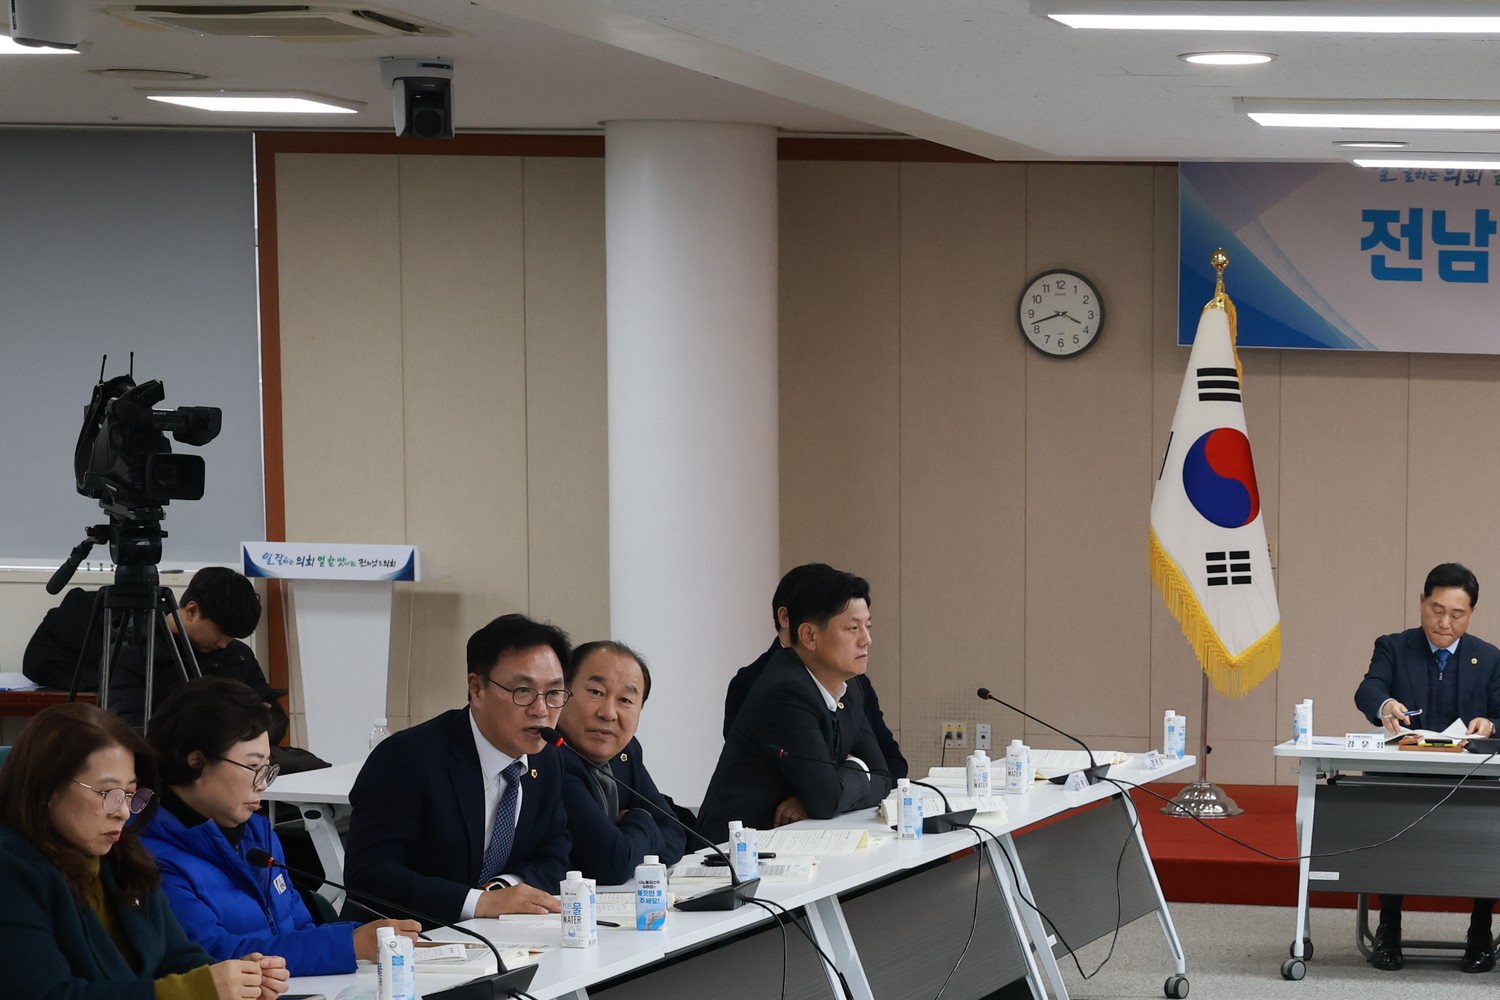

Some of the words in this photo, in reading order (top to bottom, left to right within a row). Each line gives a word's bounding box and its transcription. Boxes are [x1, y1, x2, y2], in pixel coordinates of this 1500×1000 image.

[1042, 284, 1050, 293] 11
[1056, 280, 1066, 290] 12
[1073, 285, 1078, 294] 1
[1032, 294, 1042, 304] 10
[1083, 295, 1090, 305] 2
[1028, 309, 1035, 318] 9
[1088, 310, 1095, 320] 3
[1033, 325, 1040, 334] 8
[1083, 325, 1090, 335] 4
[1044, 334, 1051, 344] 7
[1057, 338, 1065, 348] 6
[1073, 334, 1080, 344] 5
[296, 555, 315, 567] 의회
[562, 915, 582, 924] WATER
